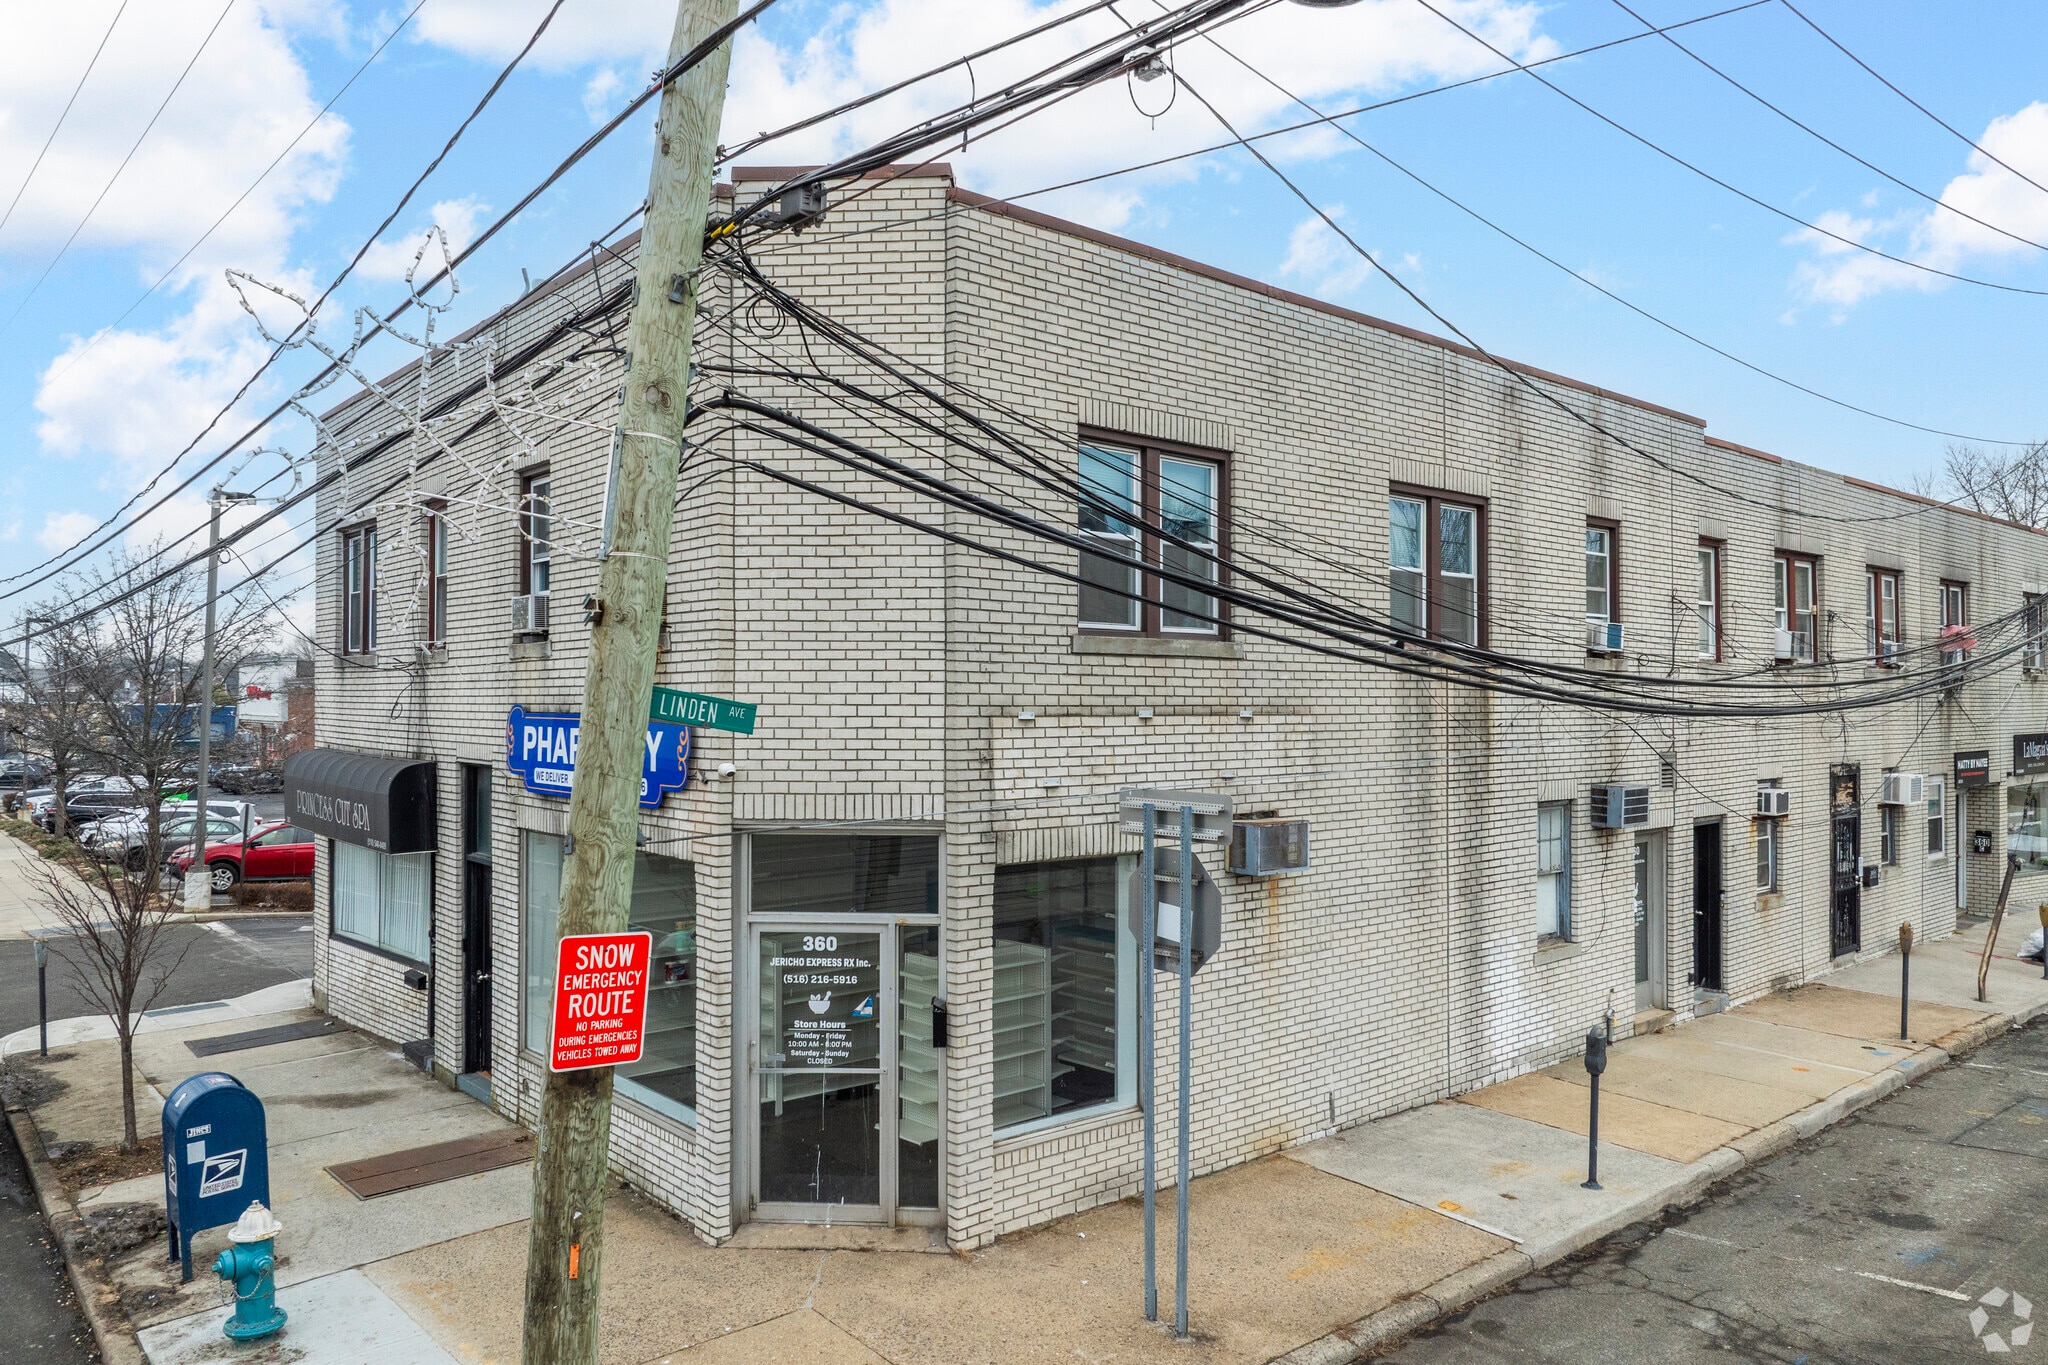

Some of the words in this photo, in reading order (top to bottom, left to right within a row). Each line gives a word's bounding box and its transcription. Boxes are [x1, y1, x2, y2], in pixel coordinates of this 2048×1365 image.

[659, 693, 719, 724] LINDEN
[728, 707, 746, 719] AVE
[536, 770, 545, 780] WE
[545, 772, 569, 784] DELIVER
[296, 789, 333, 822] PRINCESS
[335, 798, 350, 826] CUT
[352, 802, 370, 831] SPA
[802, 936, 838, 951] 360
[575, 943, 635, 970] SNOW
[769, 957, 805, 967] JERICHO
[806, 957, 842, 967] EXPRESS
[843, 958, 855, 967] RX
[856, 958, 871, 968] Inc.
[563, 970, 643, 991] EMERGENCY
[783, 974, 809, 984] (516)
[810, 975, 858, 984] 216-5916
[568, 990, 635, 1019] ROUTE
[576, 1021, 588, 1032] NO
[590, 1018, 623, 1031] PARKING
[794, 1020, 818, 1028] Store
[819, 1020, 846, 1029] Hours
[558, 1035, 586, 1048] DURING
[588, 1030, 638, 1045] EMERGENCIES
[794, 1032, 820, 1040] Monday
[825, 1033, 846, 1041] Friday
[557, 1048, 592, 1061] VEHICLES
[595, 1045, 618, 1057] TOWED
[620, 1043, 638, 1054] AWAY
[791, 1050, 820, 1058] Saturday
[825, 1050, 849, 1058] Sunday
